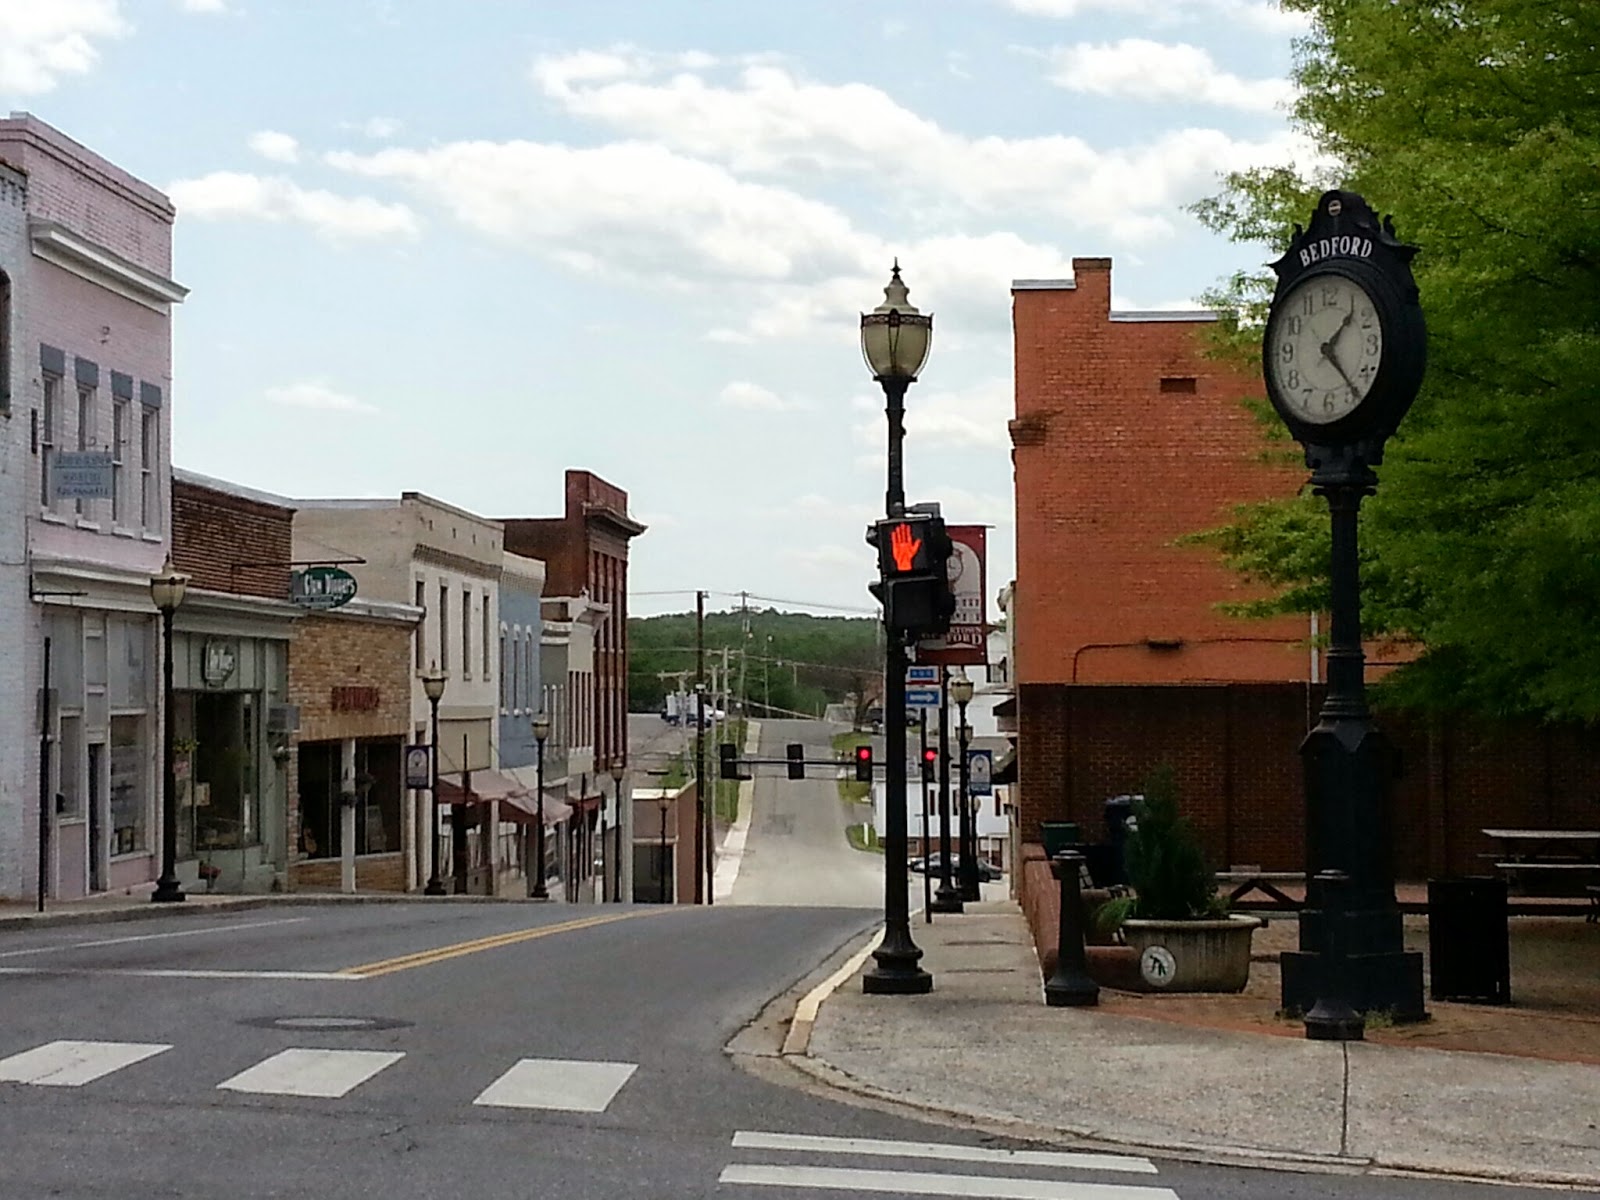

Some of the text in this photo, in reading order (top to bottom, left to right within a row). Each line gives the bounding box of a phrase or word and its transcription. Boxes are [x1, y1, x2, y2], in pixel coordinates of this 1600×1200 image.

[1299, 235, 1372, 267] BEDFORD
[1303, 293, 1313, 316] 11
[1322, 287, 1338, 307] 12
[1287, 315, 1301, 336] 10
[1361, 307, 1373, 330] 2
[1282, 343, 1294, 364] 9
[1366, 334, 1379, 357] 3
[1288, 369, 1299, 391] 8
[1302, 388, 1313, 410] 7
[1323, 392, 1335, 413] 6
